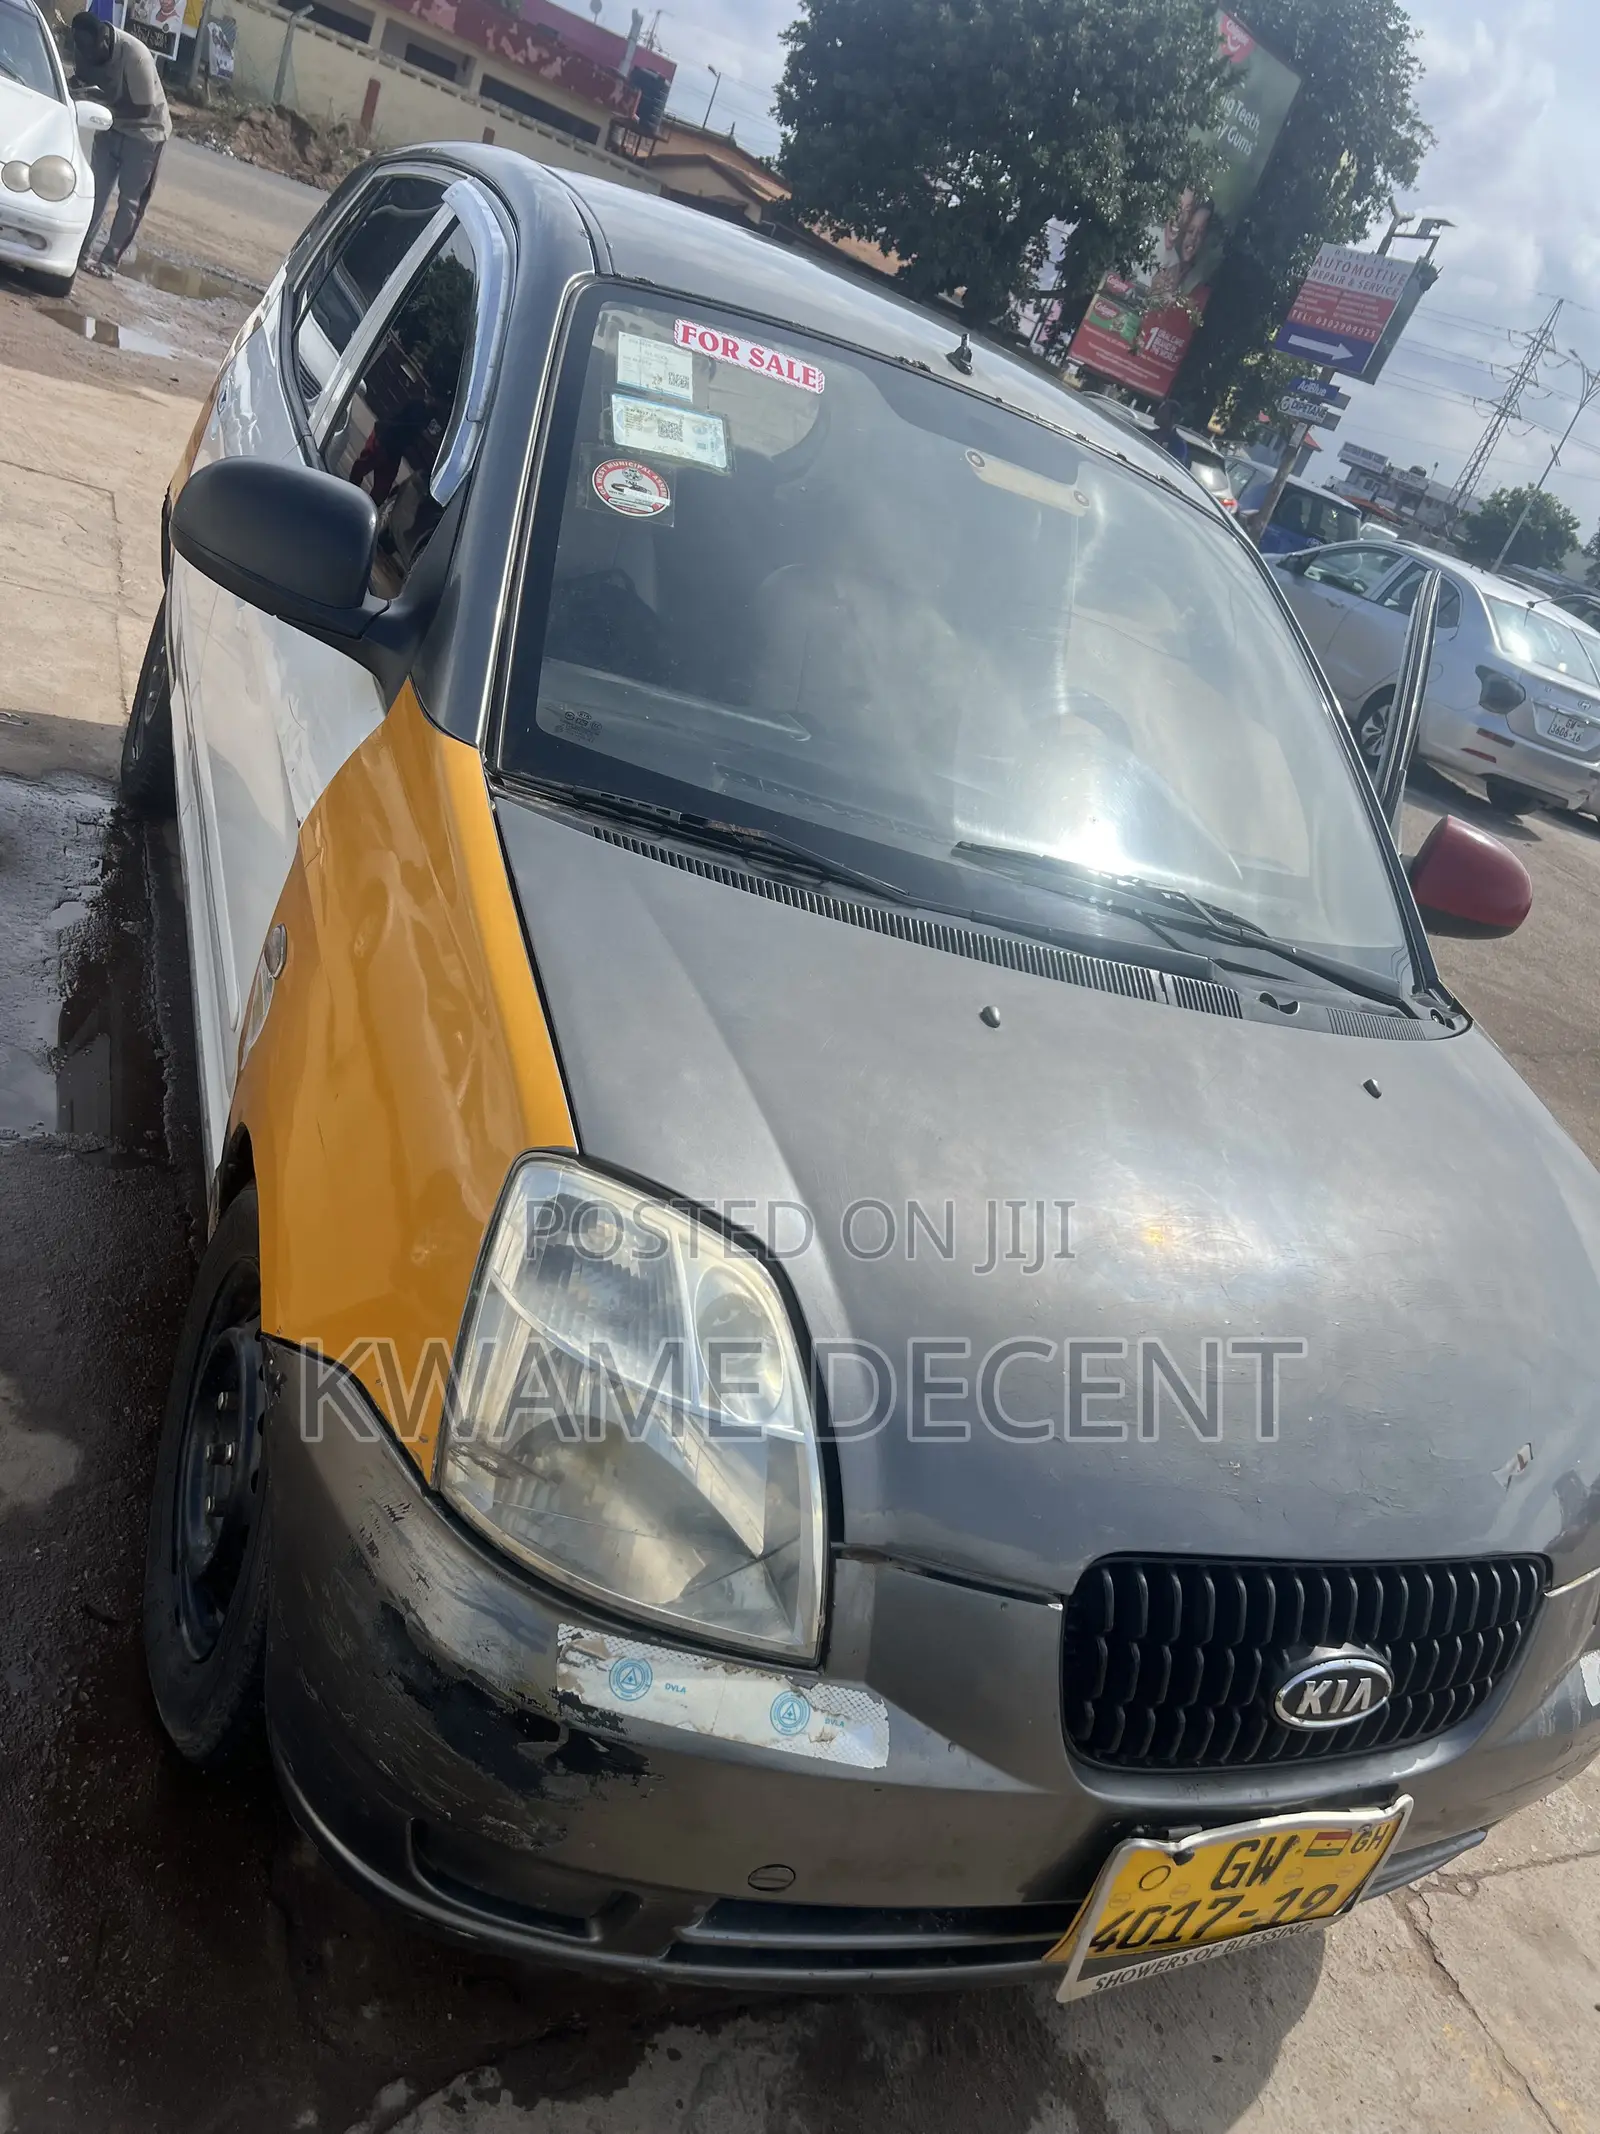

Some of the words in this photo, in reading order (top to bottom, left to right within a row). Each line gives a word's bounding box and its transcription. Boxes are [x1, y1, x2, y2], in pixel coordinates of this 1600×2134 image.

[1310, 269, 1345, 285] REPAIR
[1347, 277, 1355, 289] &
[1358, 280, 1399, 297] SERVICE
[1313, 256, 1407, 286] AUTOMOTIVE
[681, 325, 740, 361] FOR
[748, 347, 817, 389] SALE
[1297, 380, 1327, 397] AdBlue
[607, 460, 651, 475] MUNICIPAL
[664, 1682, 687, 1695] DVLA
[1295, 1676, 1373, 1715] KIA
[824, 1717, 845, 1729] DVLA
[1350, 1823, 1391, 1855] GH
[1210, 1834, 1300, 1891] GW
[1090, 1883, 1340, 1953] 4017-19
[1091, 1952, 1190, 1992] SHOWERS
[1193, 1943, 1220, 1964] OF
[1223, 1921, 1313, 1957] BLESSING
